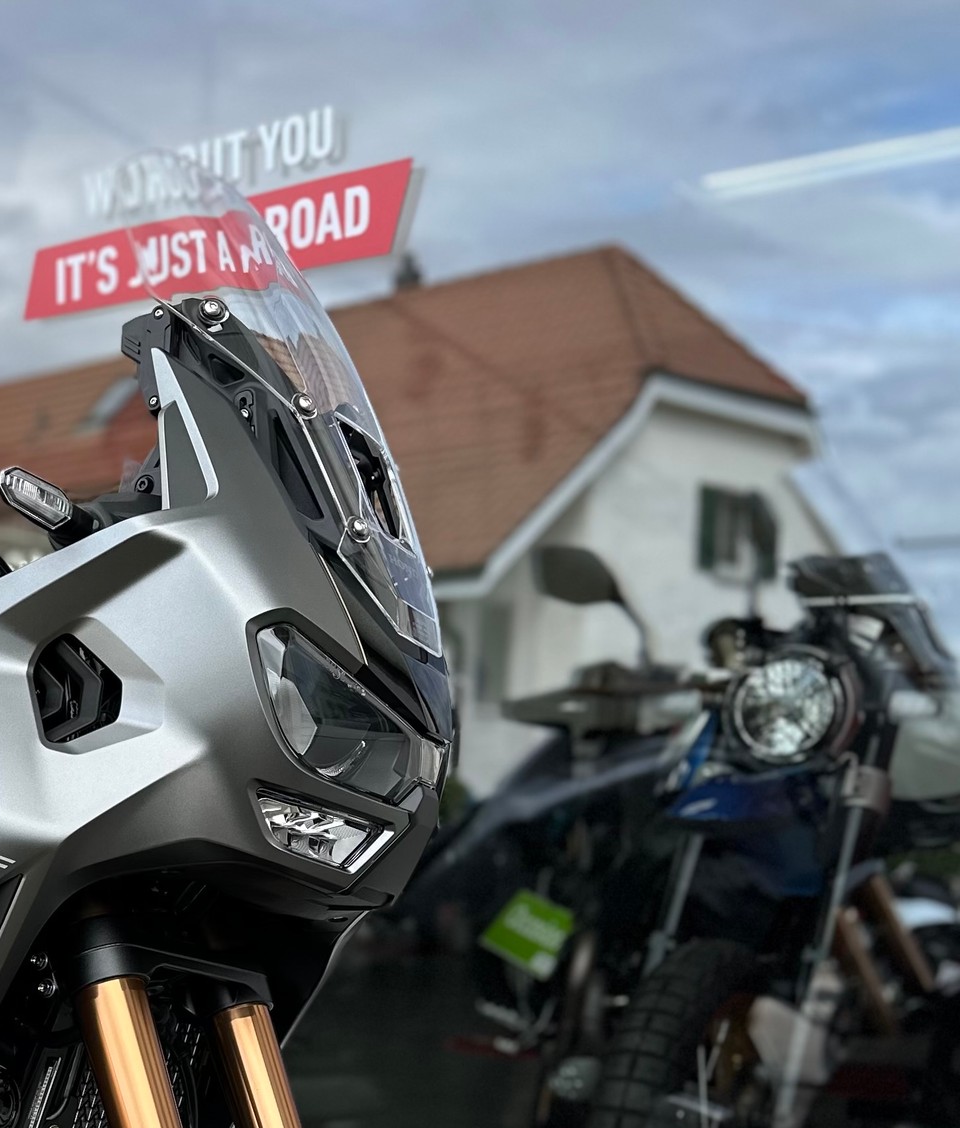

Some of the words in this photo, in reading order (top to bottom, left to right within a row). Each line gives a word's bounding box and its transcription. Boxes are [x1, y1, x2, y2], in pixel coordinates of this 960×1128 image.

[258, 106, 334, 171] YOU
[55, 246, 119, 305] IT'S
[127, 229, 207, 289] JUST
[218, 230, 236, 273] A
[264, 185, 371, 252] ROAD
